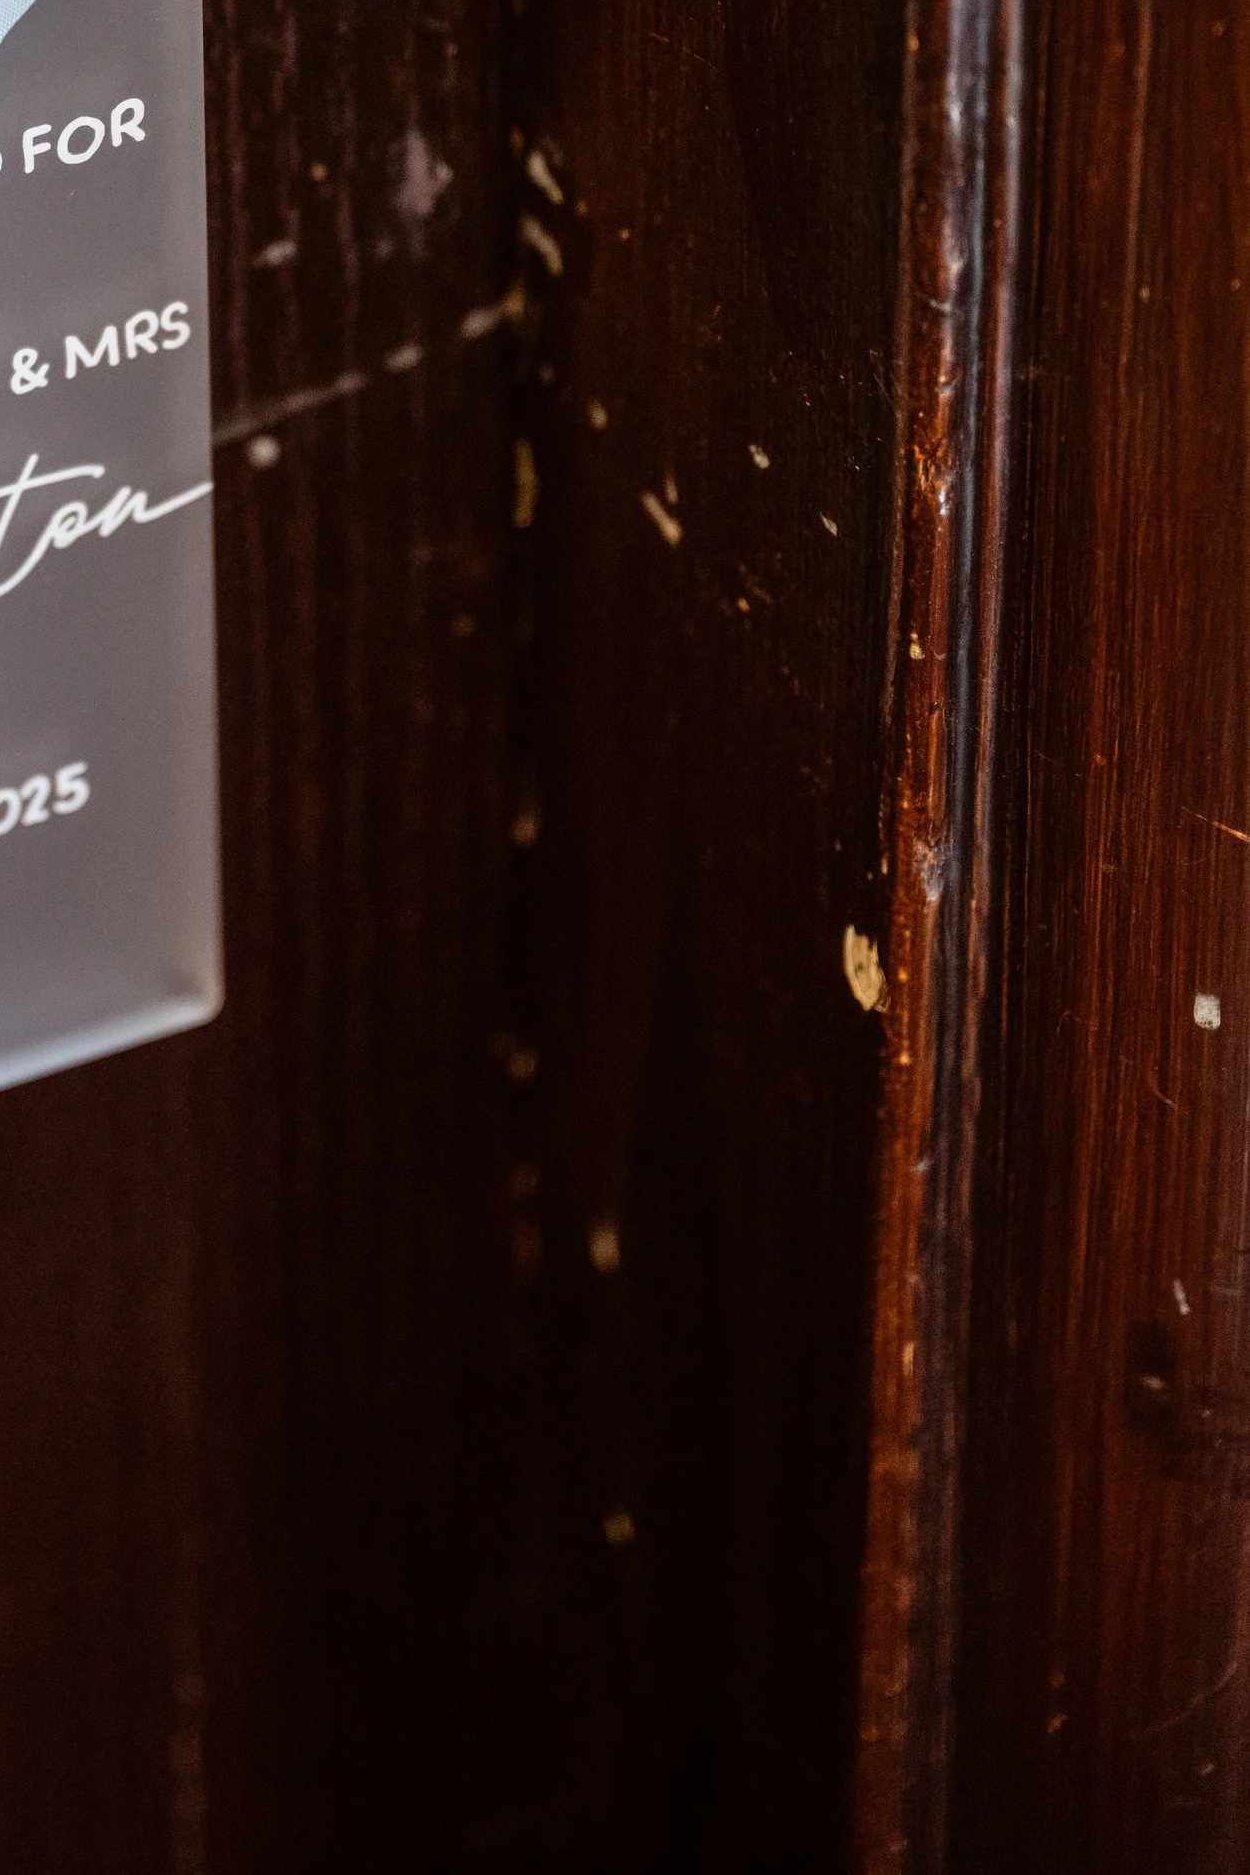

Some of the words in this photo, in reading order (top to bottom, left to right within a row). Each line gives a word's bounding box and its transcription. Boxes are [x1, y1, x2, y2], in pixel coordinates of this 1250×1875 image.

[20, 96, 147, 176] FOR
[9, 347, 51, 396] &
[62, 299, 192, 381] MRS
